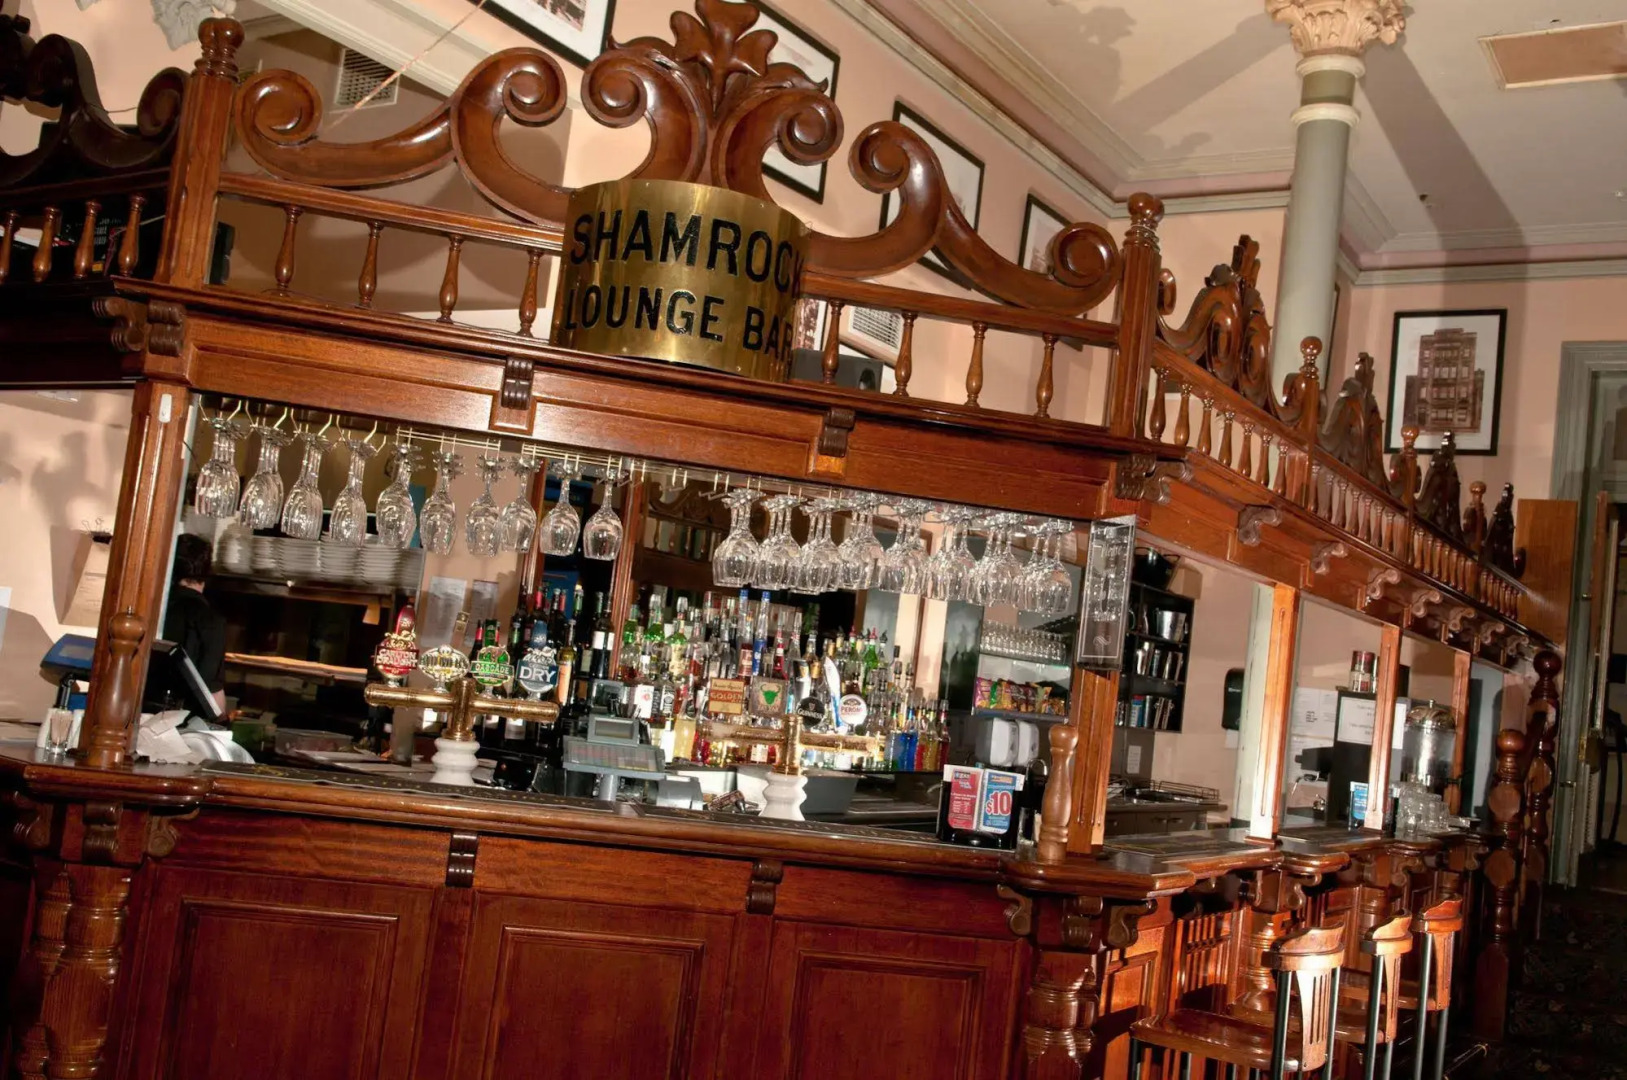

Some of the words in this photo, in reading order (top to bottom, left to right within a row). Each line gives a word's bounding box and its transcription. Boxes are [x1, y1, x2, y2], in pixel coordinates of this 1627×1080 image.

[565, 284, 725, 343] LOUNGE
[743, 305, 793, 366] BAR
[379, 648, 417, 661] CARLTON
[376, 655, 418, 668] DRAUGHT
[475, 663, 511, 676] CASCADE
[519, 666, 556, 683] DRY
[710, 691, 743, 700] GOLDEN
[797, 707, 824, 720] GUINNESS
[986, 790, 1013, 816] $10
